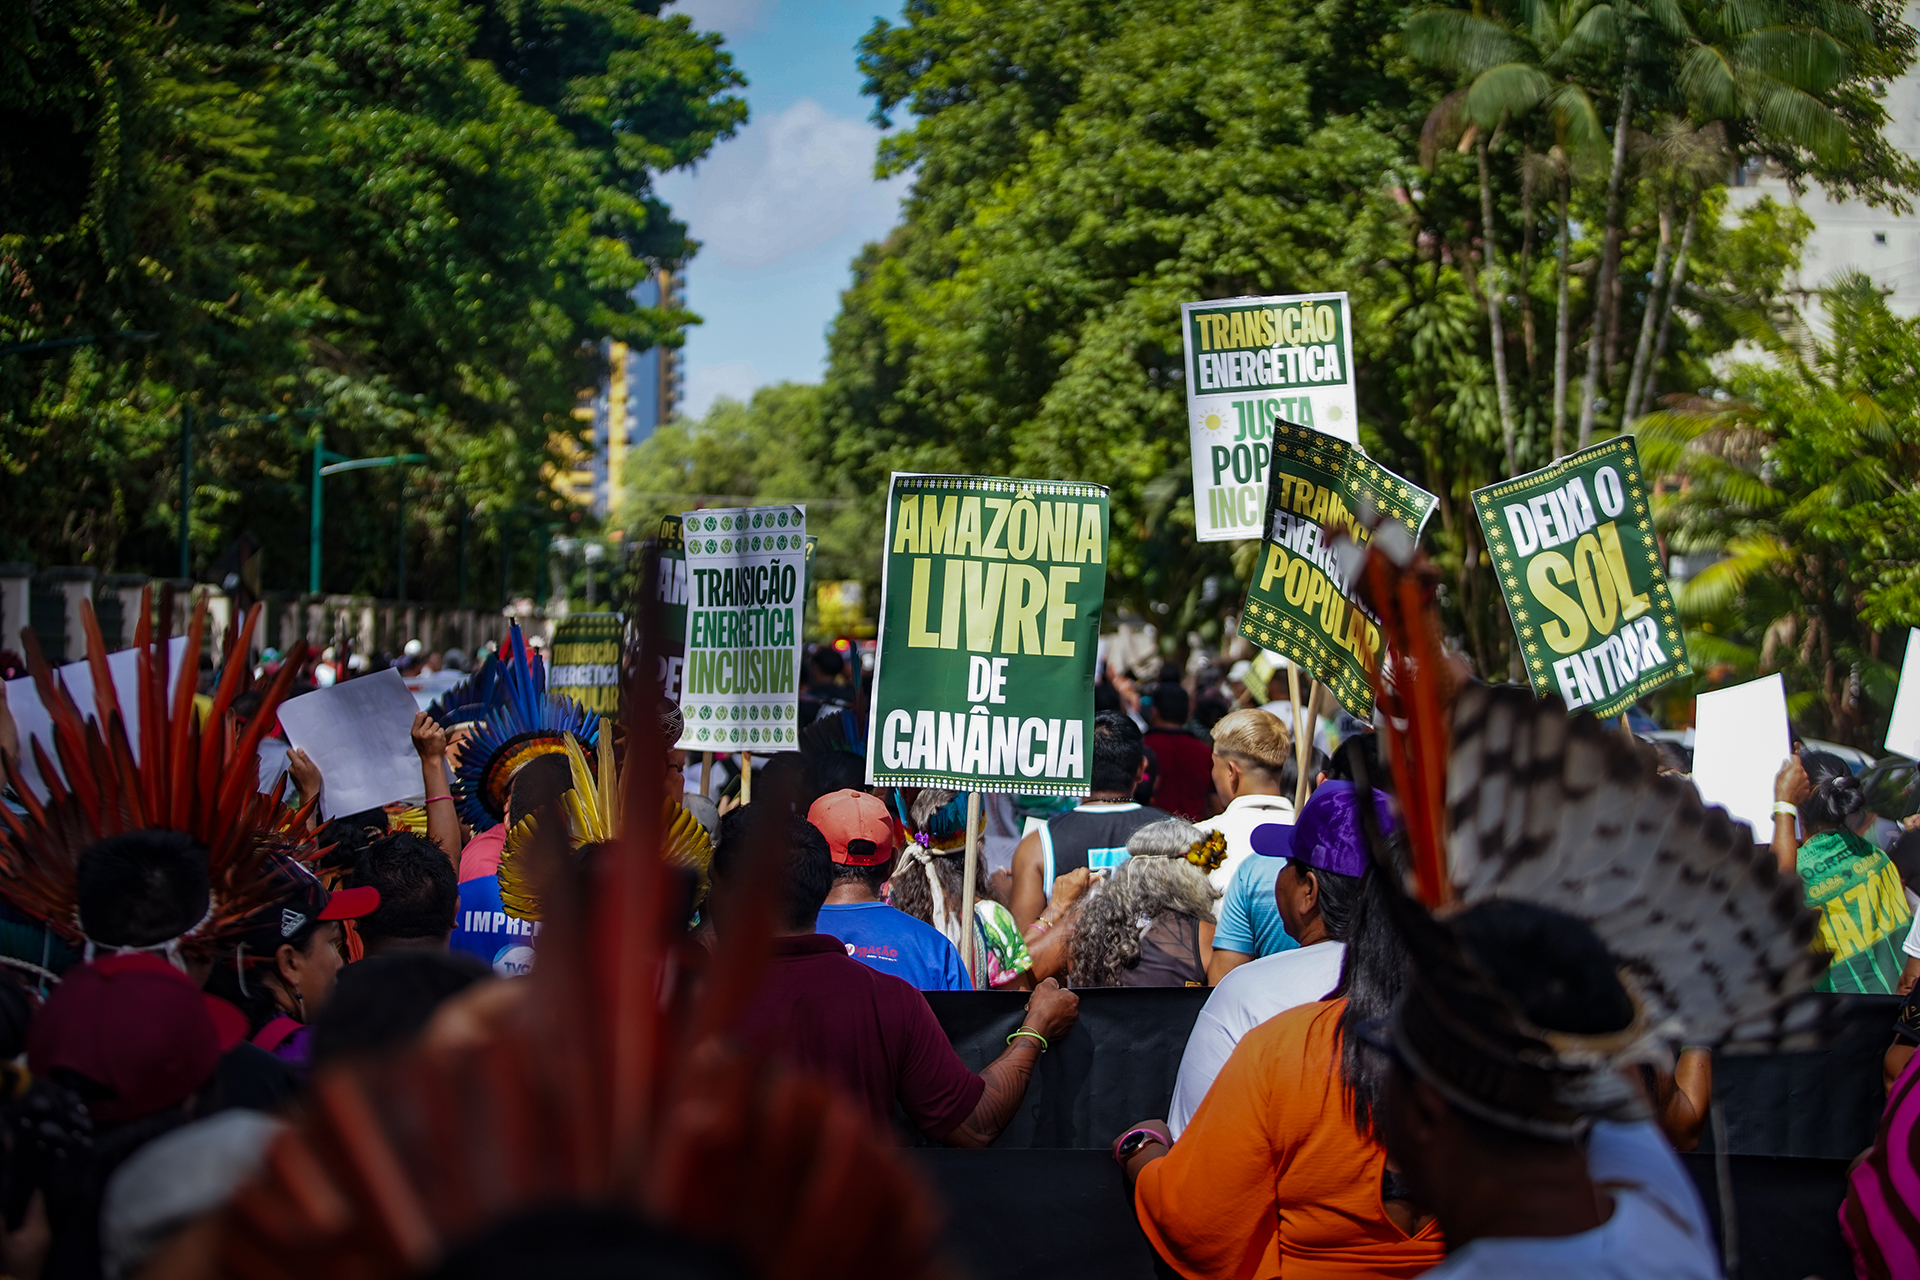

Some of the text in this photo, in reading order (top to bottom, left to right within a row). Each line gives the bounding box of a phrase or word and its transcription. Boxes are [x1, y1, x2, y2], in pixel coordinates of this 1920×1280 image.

[1195, 302, 1337, 350] TRANSIÇÃO
[1198, 343, 1343, 390] ENERGÉTICA
[1232, 396, 1315, 442] JUSTA
[1211, 443, 1270, 486] POP
[1593, 465, 1626, 518] O
[892, 490, 1103, 564] AMAZÔNIA
[693, 558, 797, 612] TRANSIÇÃO
[1272, 508, 1382, 627] ENERG
[1526, 521, 1652, 655] SOL
[690, 603, 795, 648] ENERGÉTICA
[907, 557, 1081, 657] LIVRE
[1259, 543, 1381, 675] POPULAR
[688, 648, 795, 695] INCLUSIVA
[967, 655, 1009, 705] DE
[1552, 615, 1668, 712] ENTRAR
[881, 705, 1084, 779] GANÂNCIA
